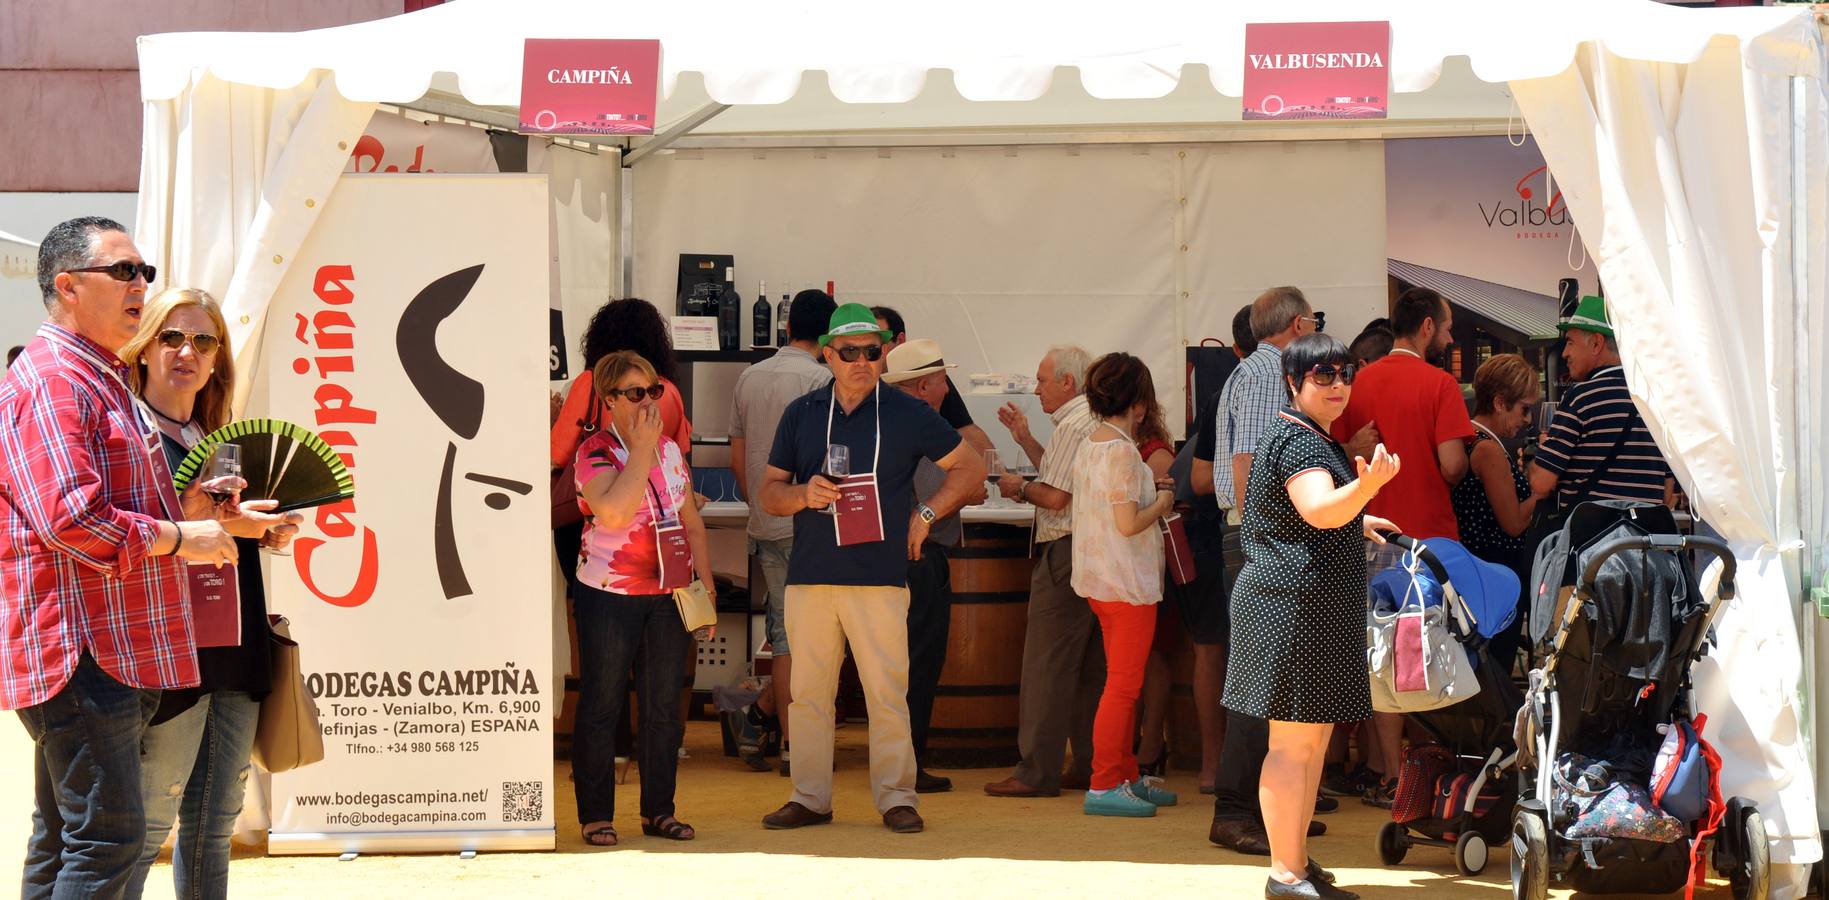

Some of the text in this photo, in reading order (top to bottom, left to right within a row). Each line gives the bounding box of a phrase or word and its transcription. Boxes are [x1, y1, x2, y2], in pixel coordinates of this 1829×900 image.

[1249, 52, 1383, 69] VALBUSENDA
[547, 66, 632, 84] CAMPIÑA
[418, 661, 540, 697] CAMPIÑA
[331, 704, 367, 717] Toro
[382, 702, 457, 717] Venialbo,
[462, 702, 494, 715] Km.
[499, 700, 541, 716] 6,900
[393, 720, 466, 737] (Zamora)
[471, 716, 540, 733] ESPAÑA
[346, 741, 479, 754] Tlfno.: +34 980 568 125
[296, 788, 489, 807] www.bodegascampina.net/
[326, 811, 487, 826] info@bodegacampina.com
